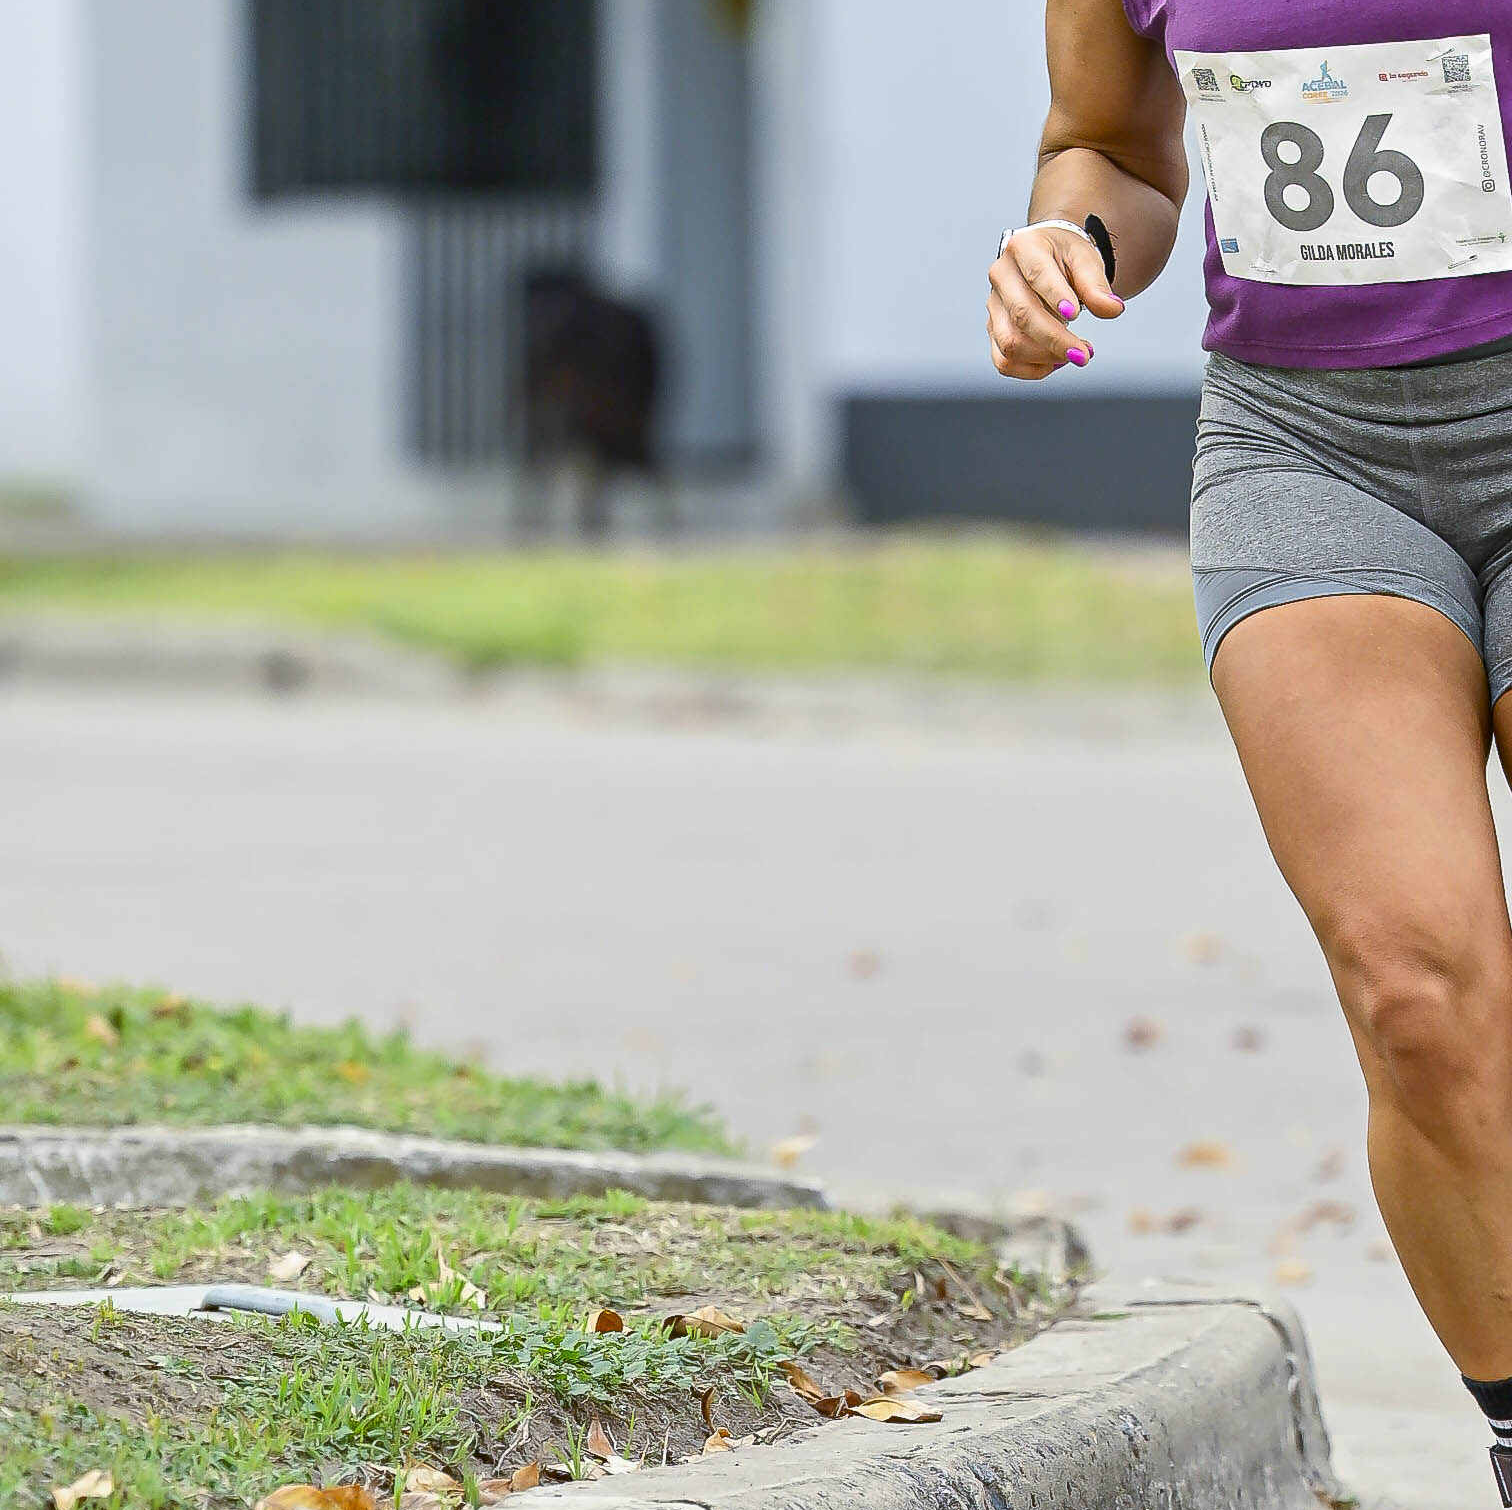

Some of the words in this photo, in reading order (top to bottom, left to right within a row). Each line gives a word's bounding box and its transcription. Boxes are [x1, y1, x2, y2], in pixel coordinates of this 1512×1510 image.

[1260, 113, 1425, 232] 86
[1299, 244, 1335, 261] GILDA
[1335, 241, 1395, 261] MORALES
